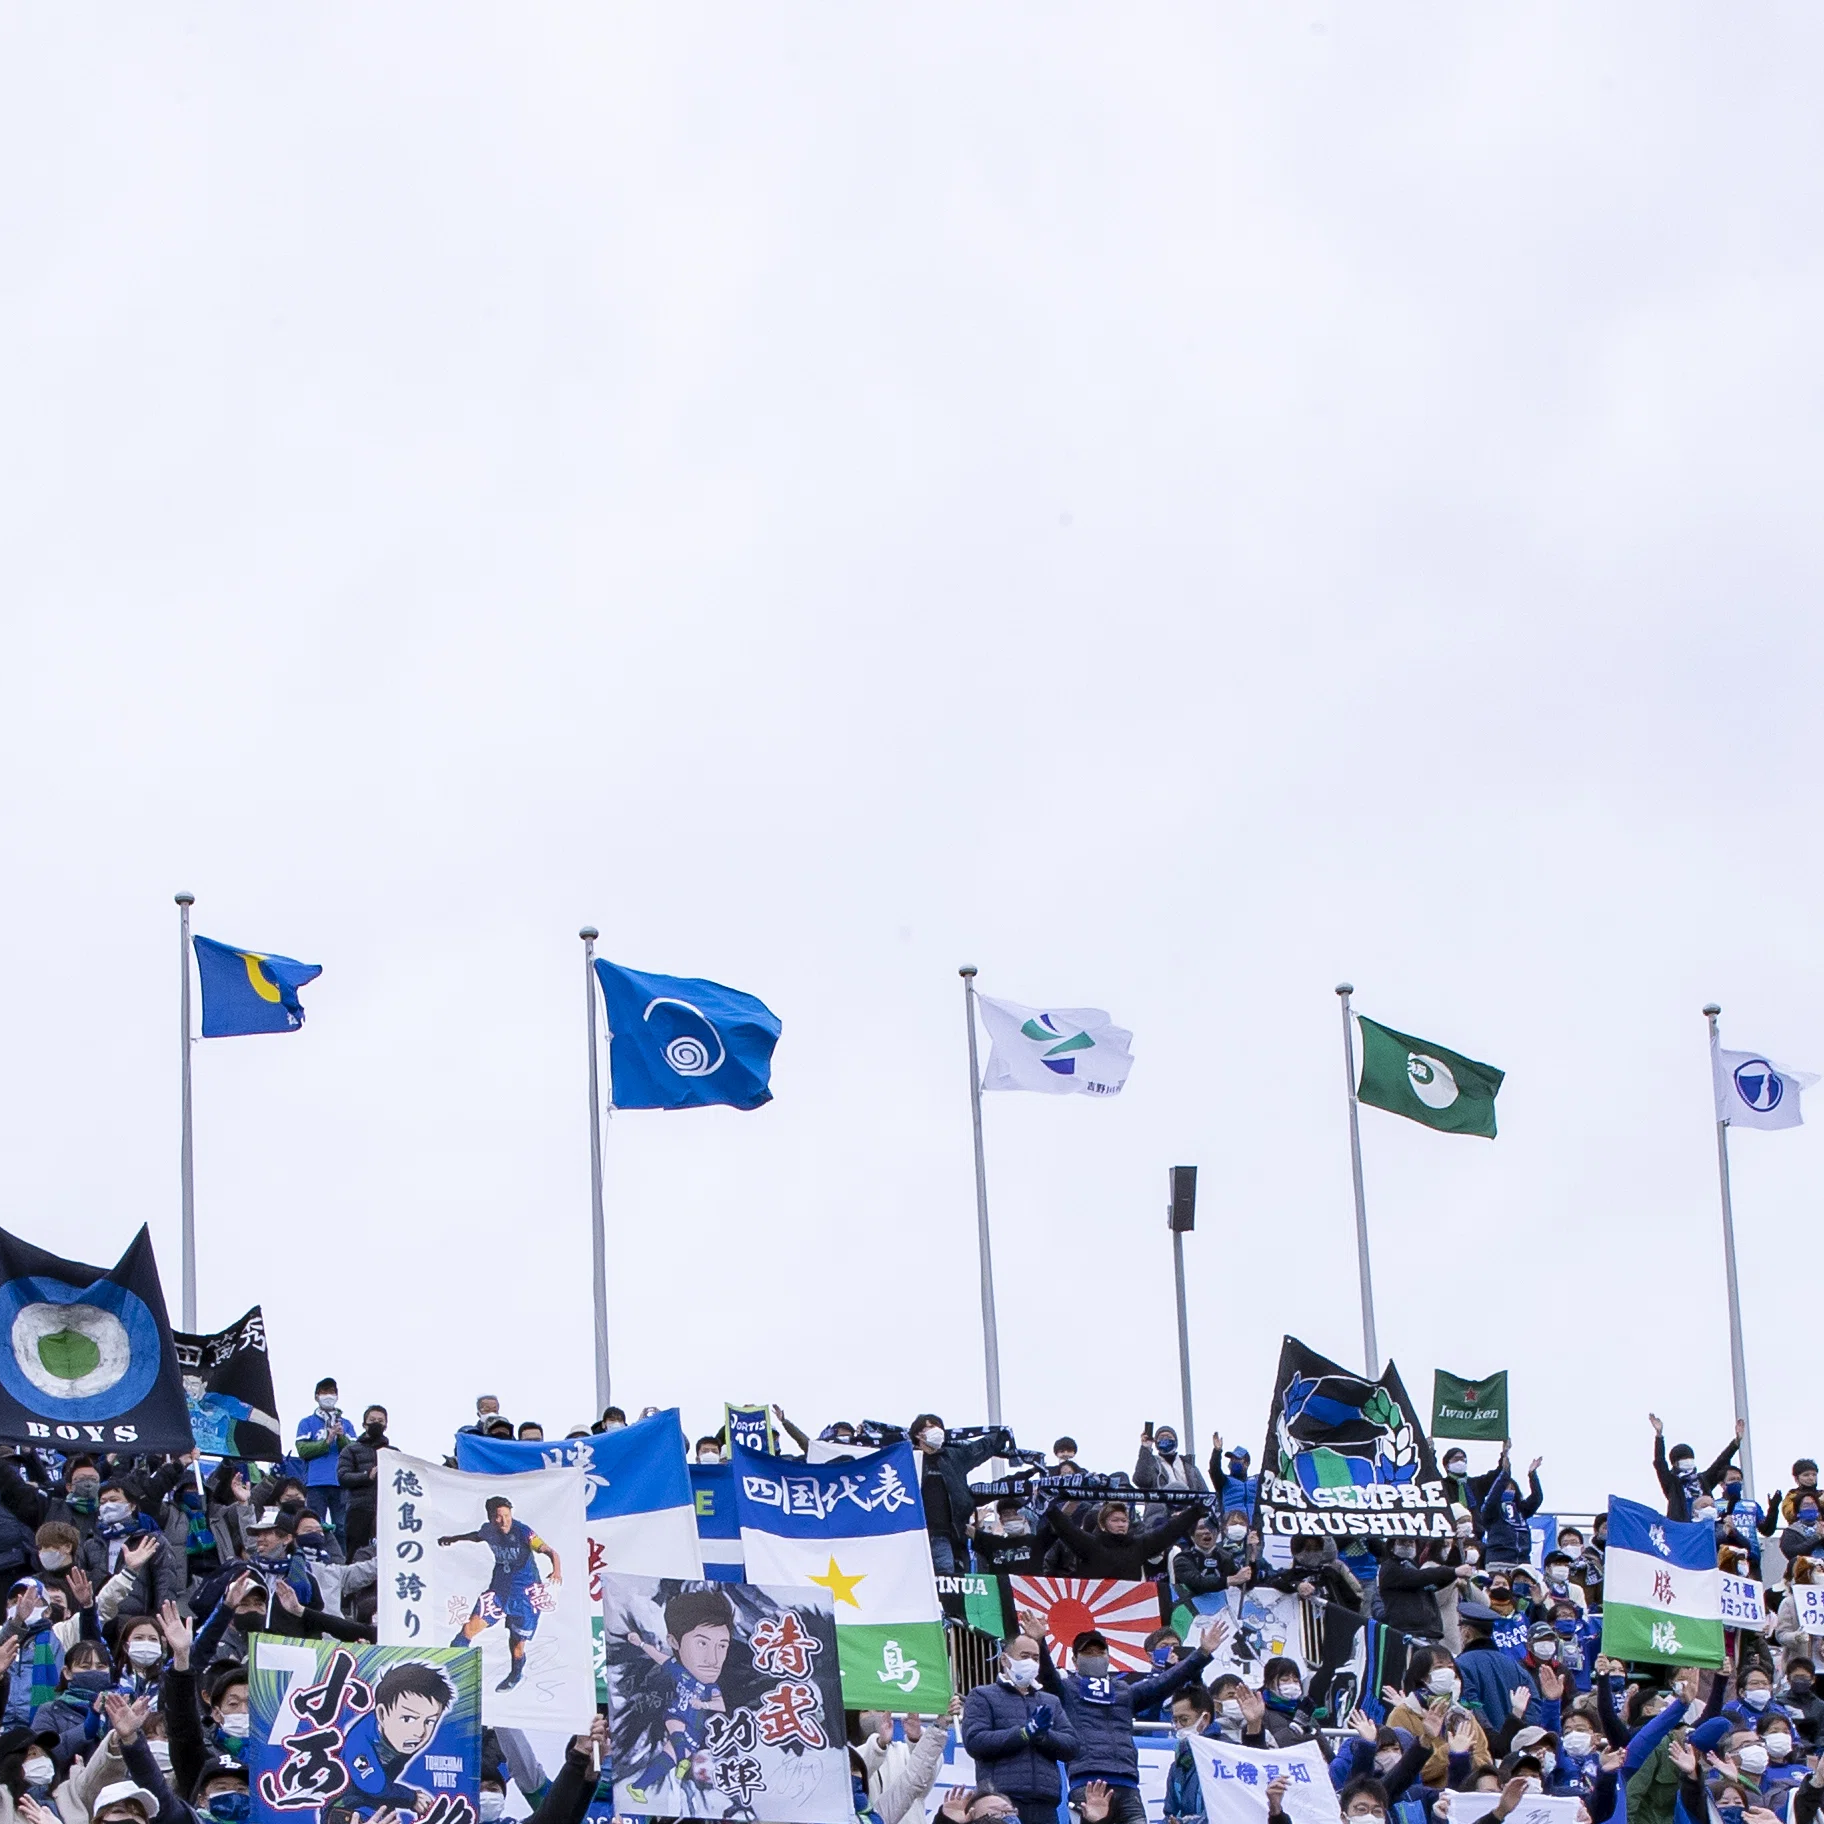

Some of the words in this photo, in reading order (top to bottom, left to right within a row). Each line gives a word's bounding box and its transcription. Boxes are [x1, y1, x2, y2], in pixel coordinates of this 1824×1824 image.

[26, 1420, 139, 1444] BOYS
[730, 1413, 766, 1430] VORTIS
[742, 1463, 916, 1520] 四国代表
[1260, 1470, 1307, 1510] PER
[1312, 1480, 1448, 1511] SEMPRE
[1260, 1505, 1456, 1538] TOKUSHIMA
[391, 1468, 428, 1639] 徳島の誇り
[1653, 1570, 1677, 1606] 勝
[1651, 1621, 1684, 1656] 勝
[749, 1610, 829, 1750] 清武
[876, 1640, 921, 1693] 島
[256, 1642, 318, 1746] 7
[258, 1647, 375, 1811] 小西
